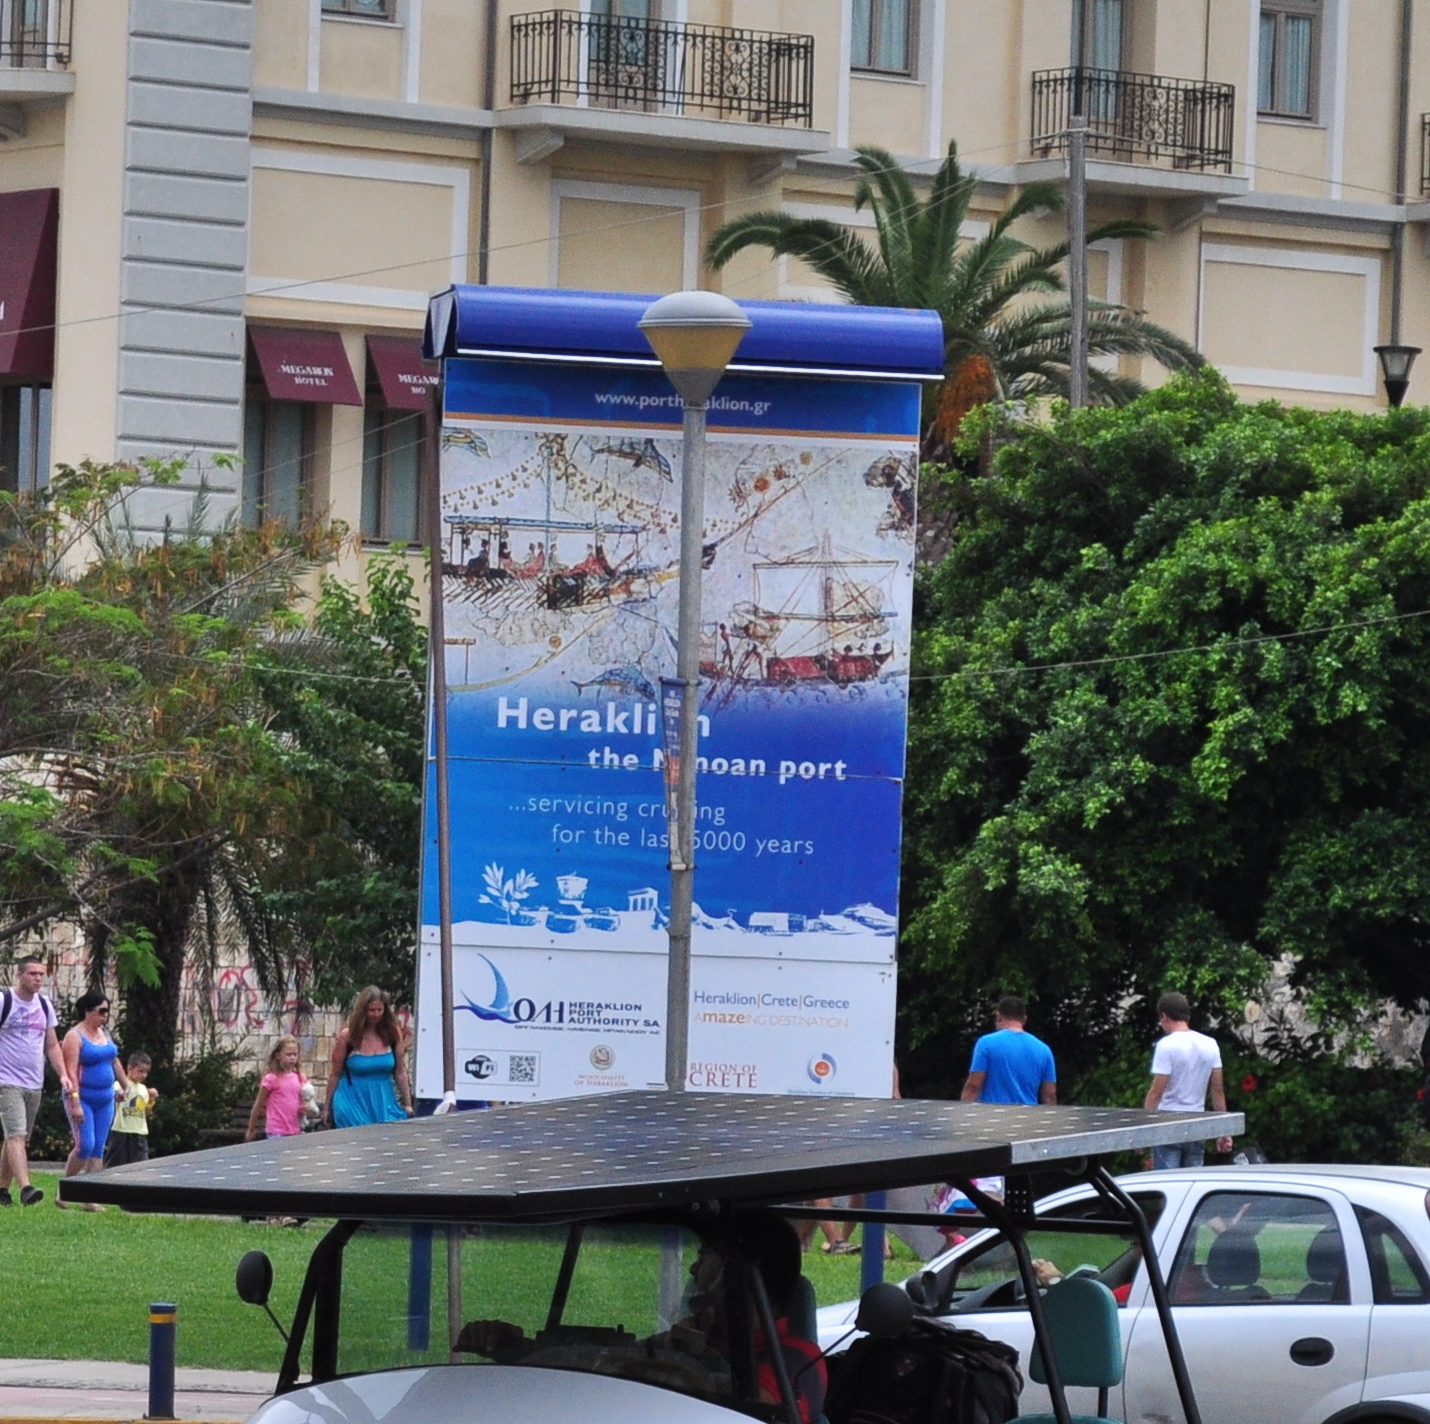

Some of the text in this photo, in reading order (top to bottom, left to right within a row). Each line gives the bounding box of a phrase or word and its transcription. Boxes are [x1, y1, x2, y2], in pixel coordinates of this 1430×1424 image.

[280, 364, 334, 376] MEGARON
[294, 376, 329, 386] HOTEL
[595, 393, 771, 416] www.porthaklion.gr
[497, 696, 711, 737] Heraklin
[588, 746, 639, 771] the
[653, 748, 766, 776] noan
[779, 757, 847, 784] port
[638, 799, 725, 826] cruing
[552, 824, 584, 844] for
[594, 826, 630, 846] the
[641, 827, 669, 848] las
[756, 838, 814, 857] years
[569, 1001, 642, 1011] HERAKLION
[569, 1009, 603, 1017] PORT
[568, 1016, 639, 1026] AUTHORITY
[769, 1015, 849, 1029] DESTINATION
[690, 1062, 757, 1074] REGION OF
[689, 1072, 758, 1089] CRETE
